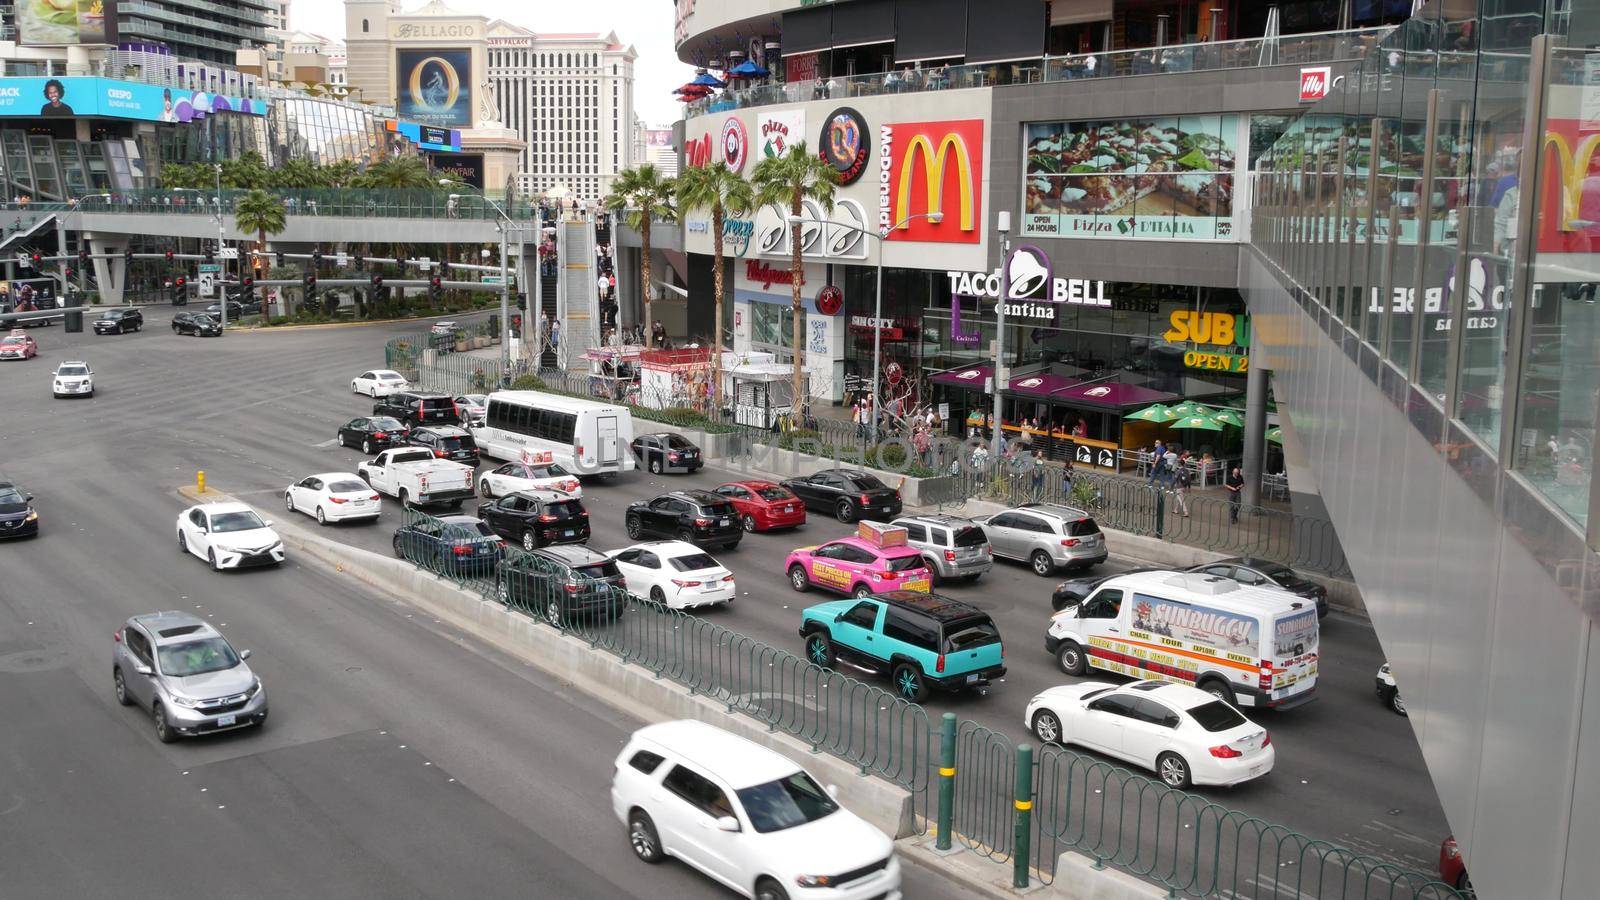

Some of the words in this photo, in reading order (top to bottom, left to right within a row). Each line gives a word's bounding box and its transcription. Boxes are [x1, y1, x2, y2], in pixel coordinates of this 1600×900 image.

[394, 24, 474, 38] BELLAGIO
[1303, 76, 1324, 97] illy
[442, 166, 475, 177] MAYFAIR
[880, 125, 893, 238] McDonald's
[1033, 215, 1051, 224] OPEN
[1073, 219, 1112, 232] Pizza
[1140, 220, 1194, 234] D'ITALIA
[1027, 224, 1036, 232] 24
[1037, 225, 1057, 233] HOURS
[947, 271, 1001, 297] TACO
[1052, 278, 1112, 305] BELL
[867, 317, 895, 328] CTY
[1184, 351, 1232, 369] OPEN
[1155, 603, 1253, 639] SUNBUGGY
[1130, 630, 1149, 640] CHASE
[1161, 637, 1183, 648] TOUR
[1193, 645, 1216, 655] EXPLORE
[1227, 653, 1252, 663] EVENTS
